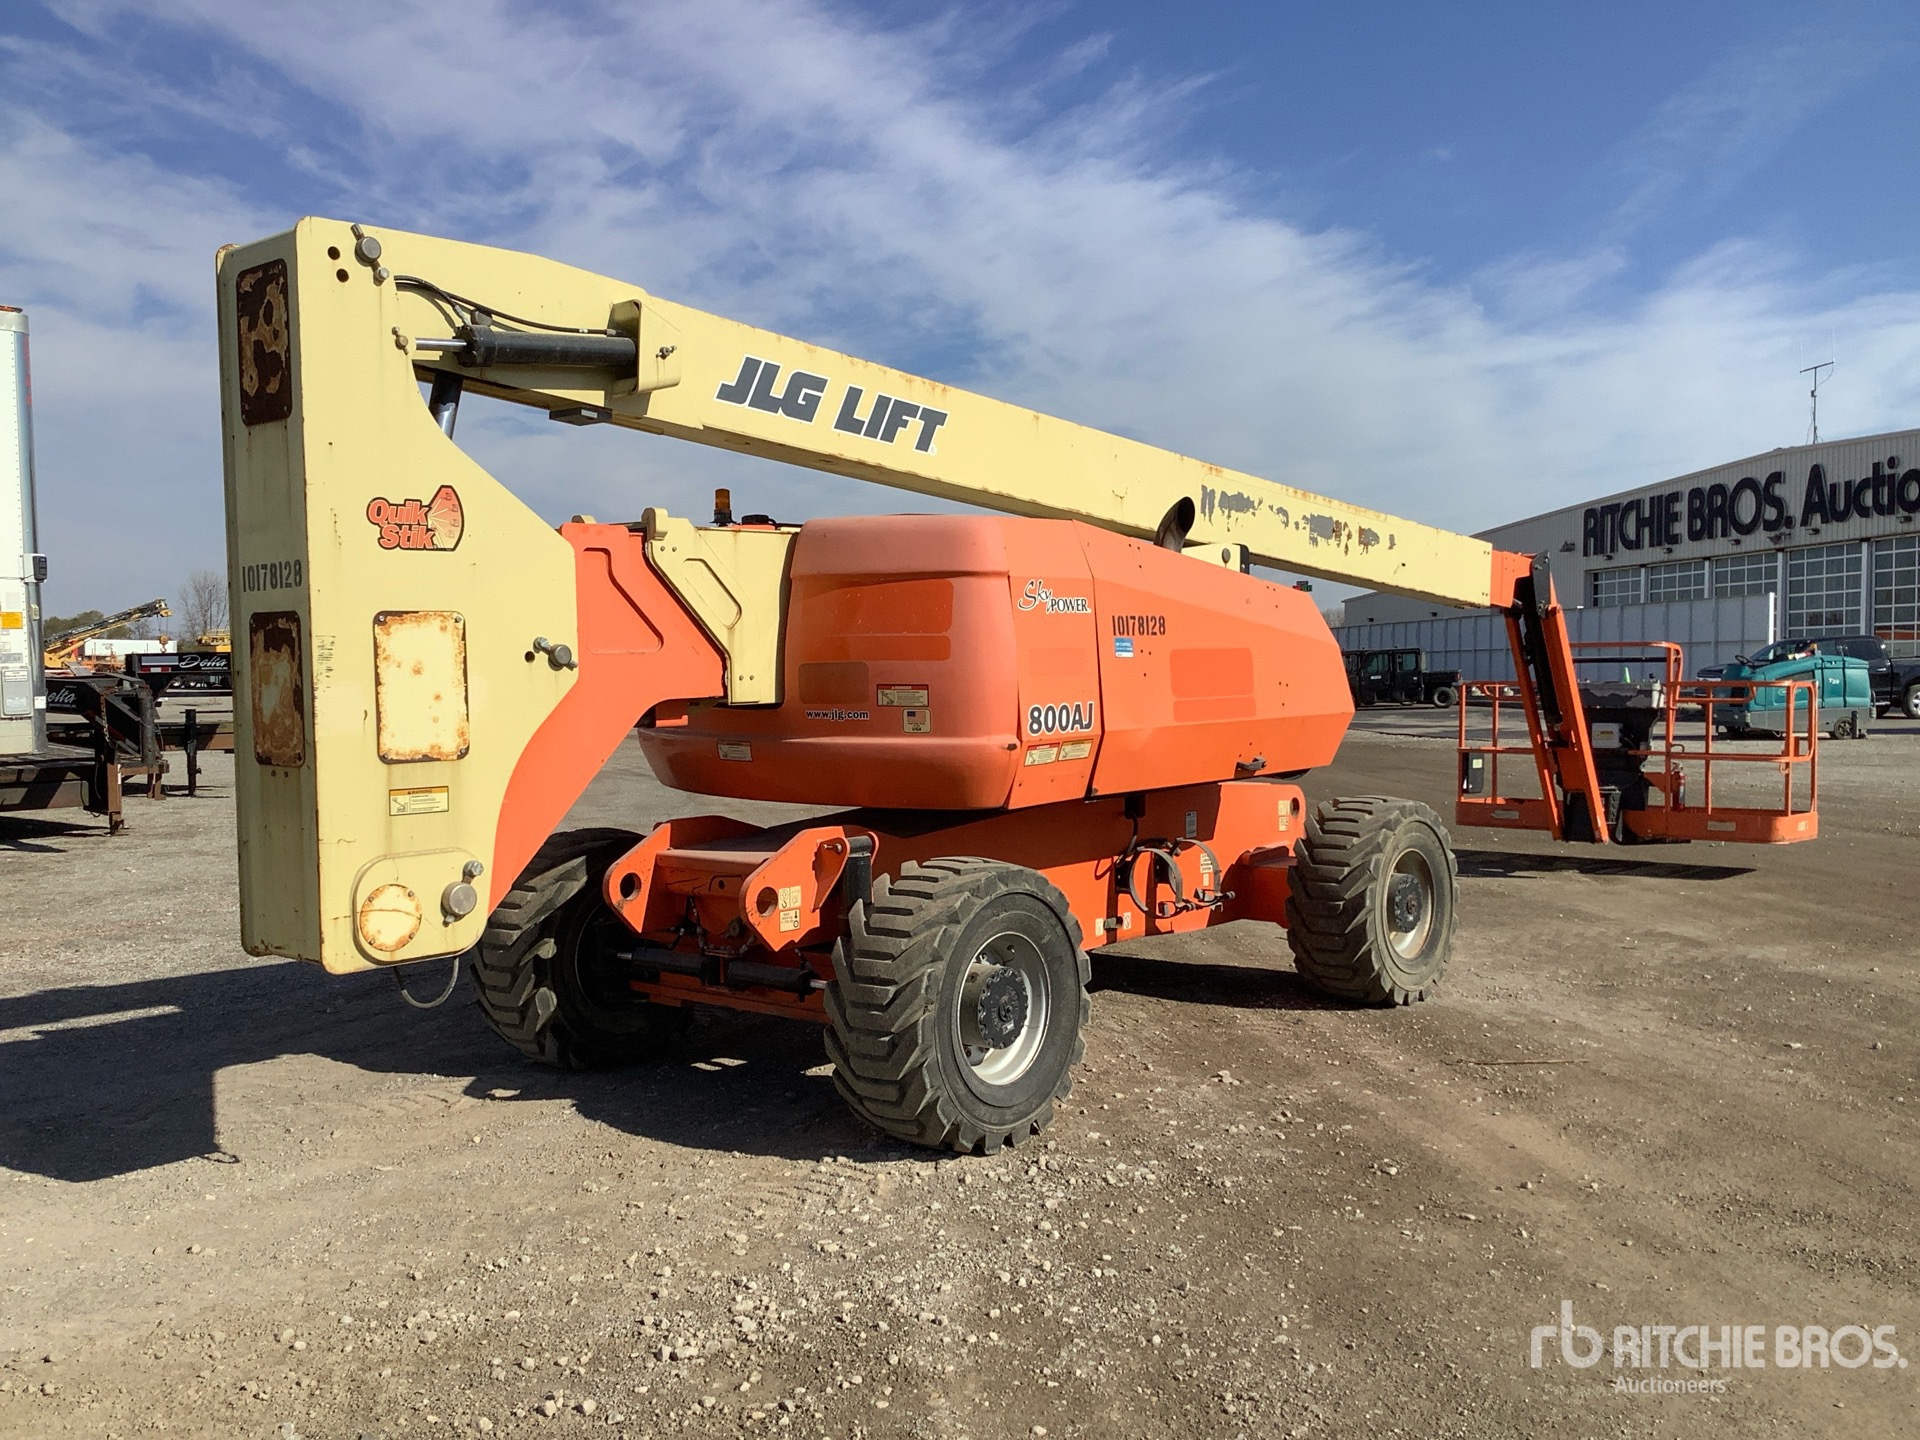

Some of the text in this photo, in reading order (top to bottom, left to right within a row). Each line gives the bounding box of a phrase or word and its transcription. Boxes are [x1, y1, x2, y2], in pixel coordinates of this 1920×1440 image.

[714, 355, 949, 453] JLG LIFT
[368, 498, 430, 528] Quik
[1583, 491, 1682, 557] RITCHIE
[1687, 471, 1795, 542] BROS.
[379, 523, 435, 549] Stik
[242, 559, 303, 593] 10178128
[1018, 579, 1089, 613] Sky POWER
[1112, 614, 1167, 637] 10178128
[179, 654, 228, 669] Delta
[46, 688, 77, 703] elta
[806, 709, 869, 721] www.jlg.com
[1028, 702, 1094, 735] 800AJ
